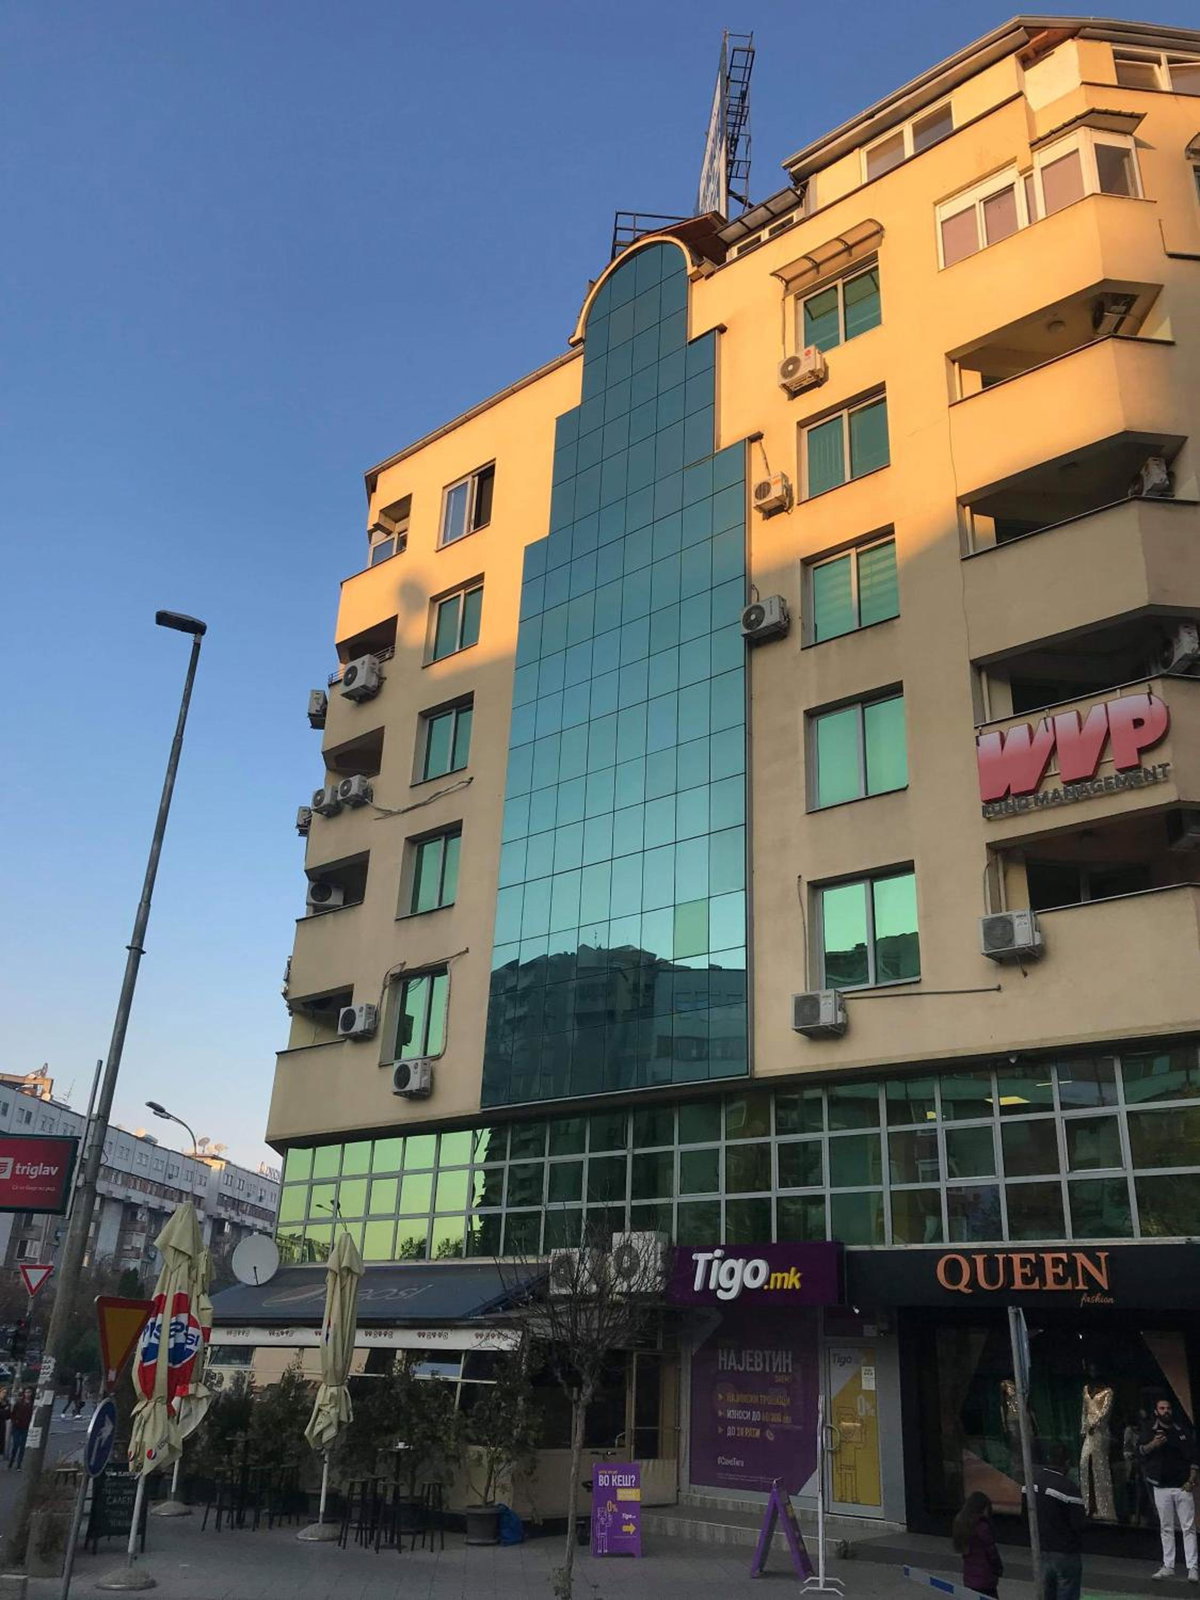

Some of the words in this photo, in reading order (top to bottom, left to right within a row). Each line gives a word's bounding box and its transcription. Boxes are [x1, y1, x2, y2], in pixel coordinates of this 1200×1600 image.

[976, 692, 1170, 803] WVP
[1034, 763, 1170, 808] MANAGEMENT
[15, 1162, 59, 1179] triglav
[692, 1248, 803, 1301] Tigo.mk
[936, 1251, 1110, 1294] QUEEN
[1080, 1292, 1116, 1308] fashion
[718, 1349, 792, 1372] НАЈЕВТИН
[832, 1352, 853, 1366] Tigo
[598, 1474, 610, 1487] ВО
[611, 1474, 636, 1487] КЕШ?
